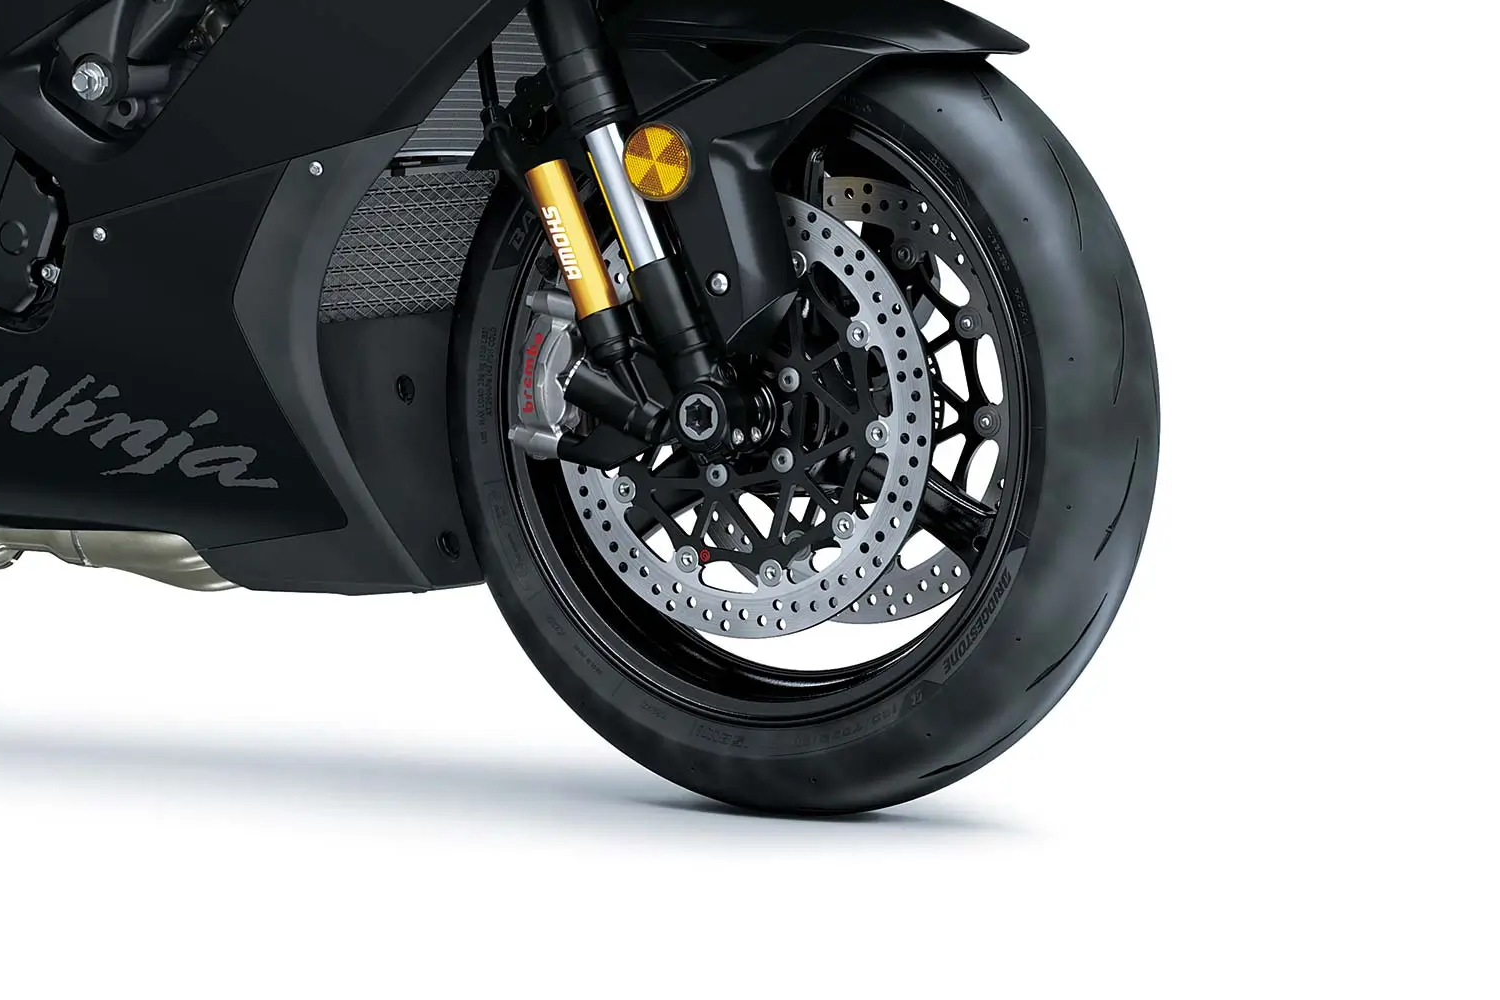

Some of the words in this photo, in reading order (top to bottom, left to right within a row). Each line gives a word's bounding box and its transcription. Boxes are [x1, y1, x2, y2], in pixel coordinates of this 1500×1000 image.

[541, 206, 583, 281] SHOWA
[522, 332, 543, 414] brembo
[942, 566, 1012, 674] BRIDGESTONE
